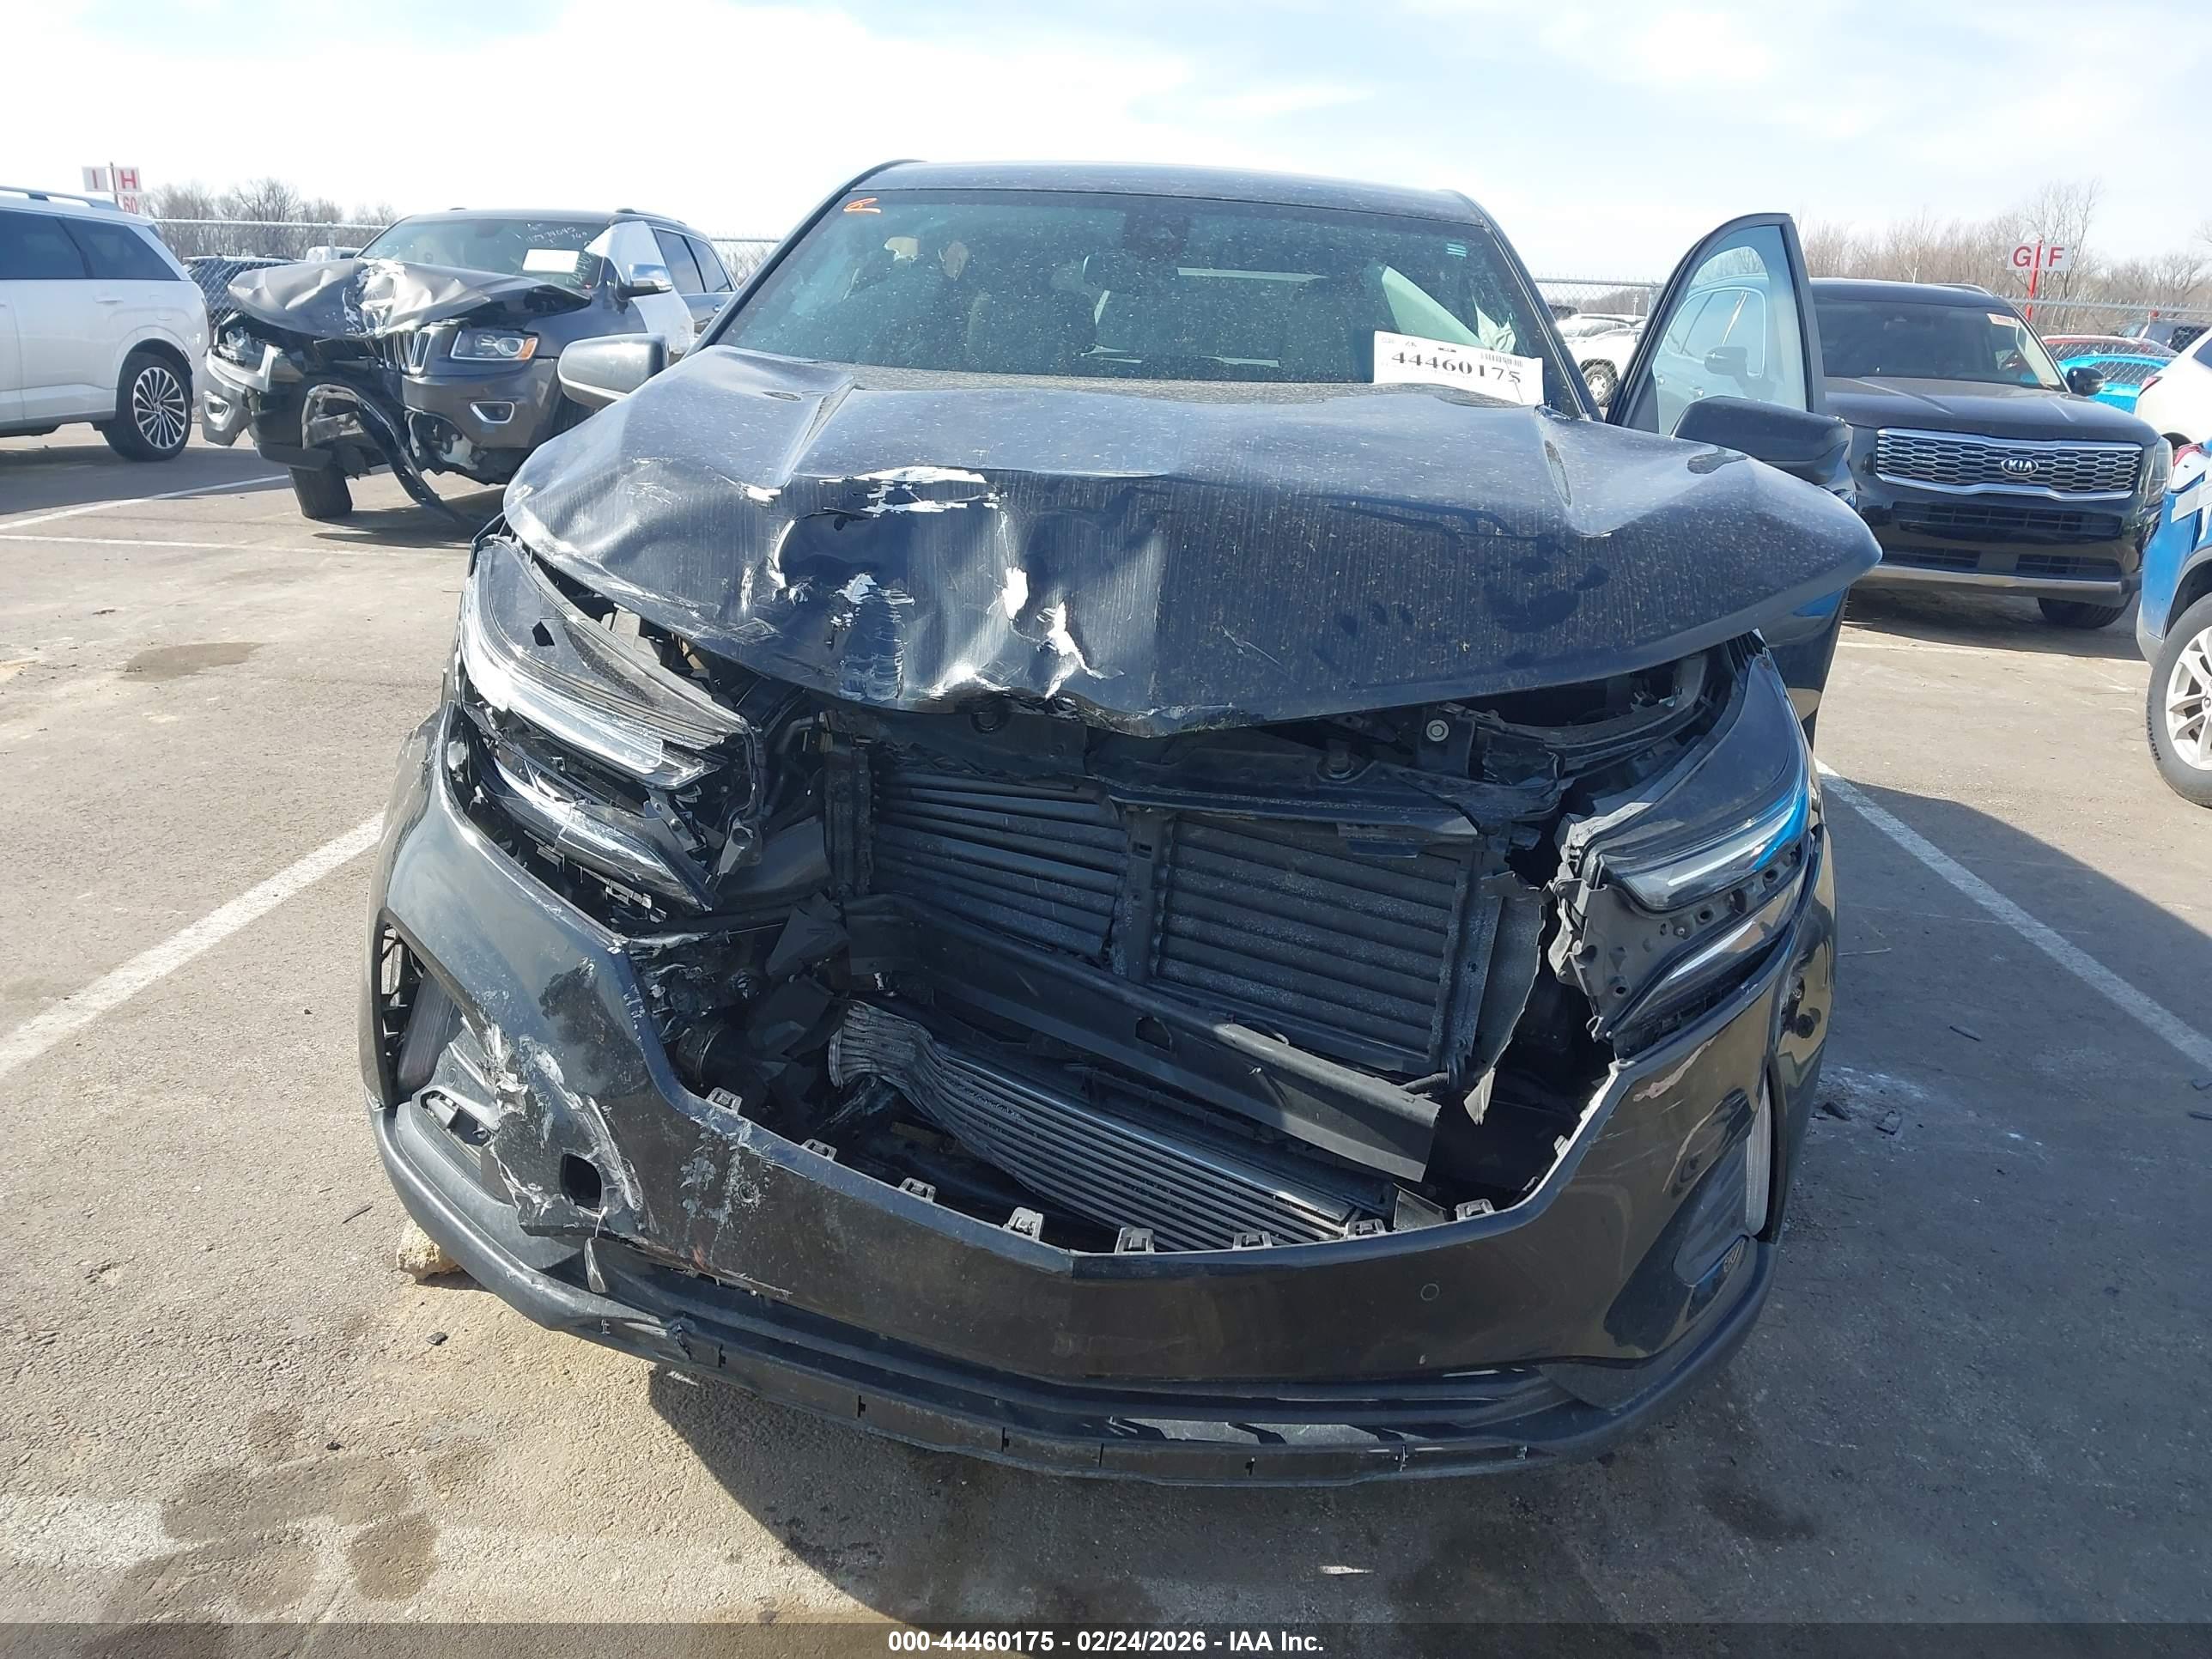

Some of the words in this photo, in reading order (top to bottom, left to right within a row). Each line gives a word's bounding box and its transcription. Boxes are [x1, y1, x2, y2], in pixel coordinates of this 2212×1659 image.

[119, 169, 137, 189] H
[2013, 246, 2032, 267] G
[2048, 246, 2064, 267] F
[1391, 351, 1522, 384] 44460175
[2008, 459, 2033, 471] KIA
